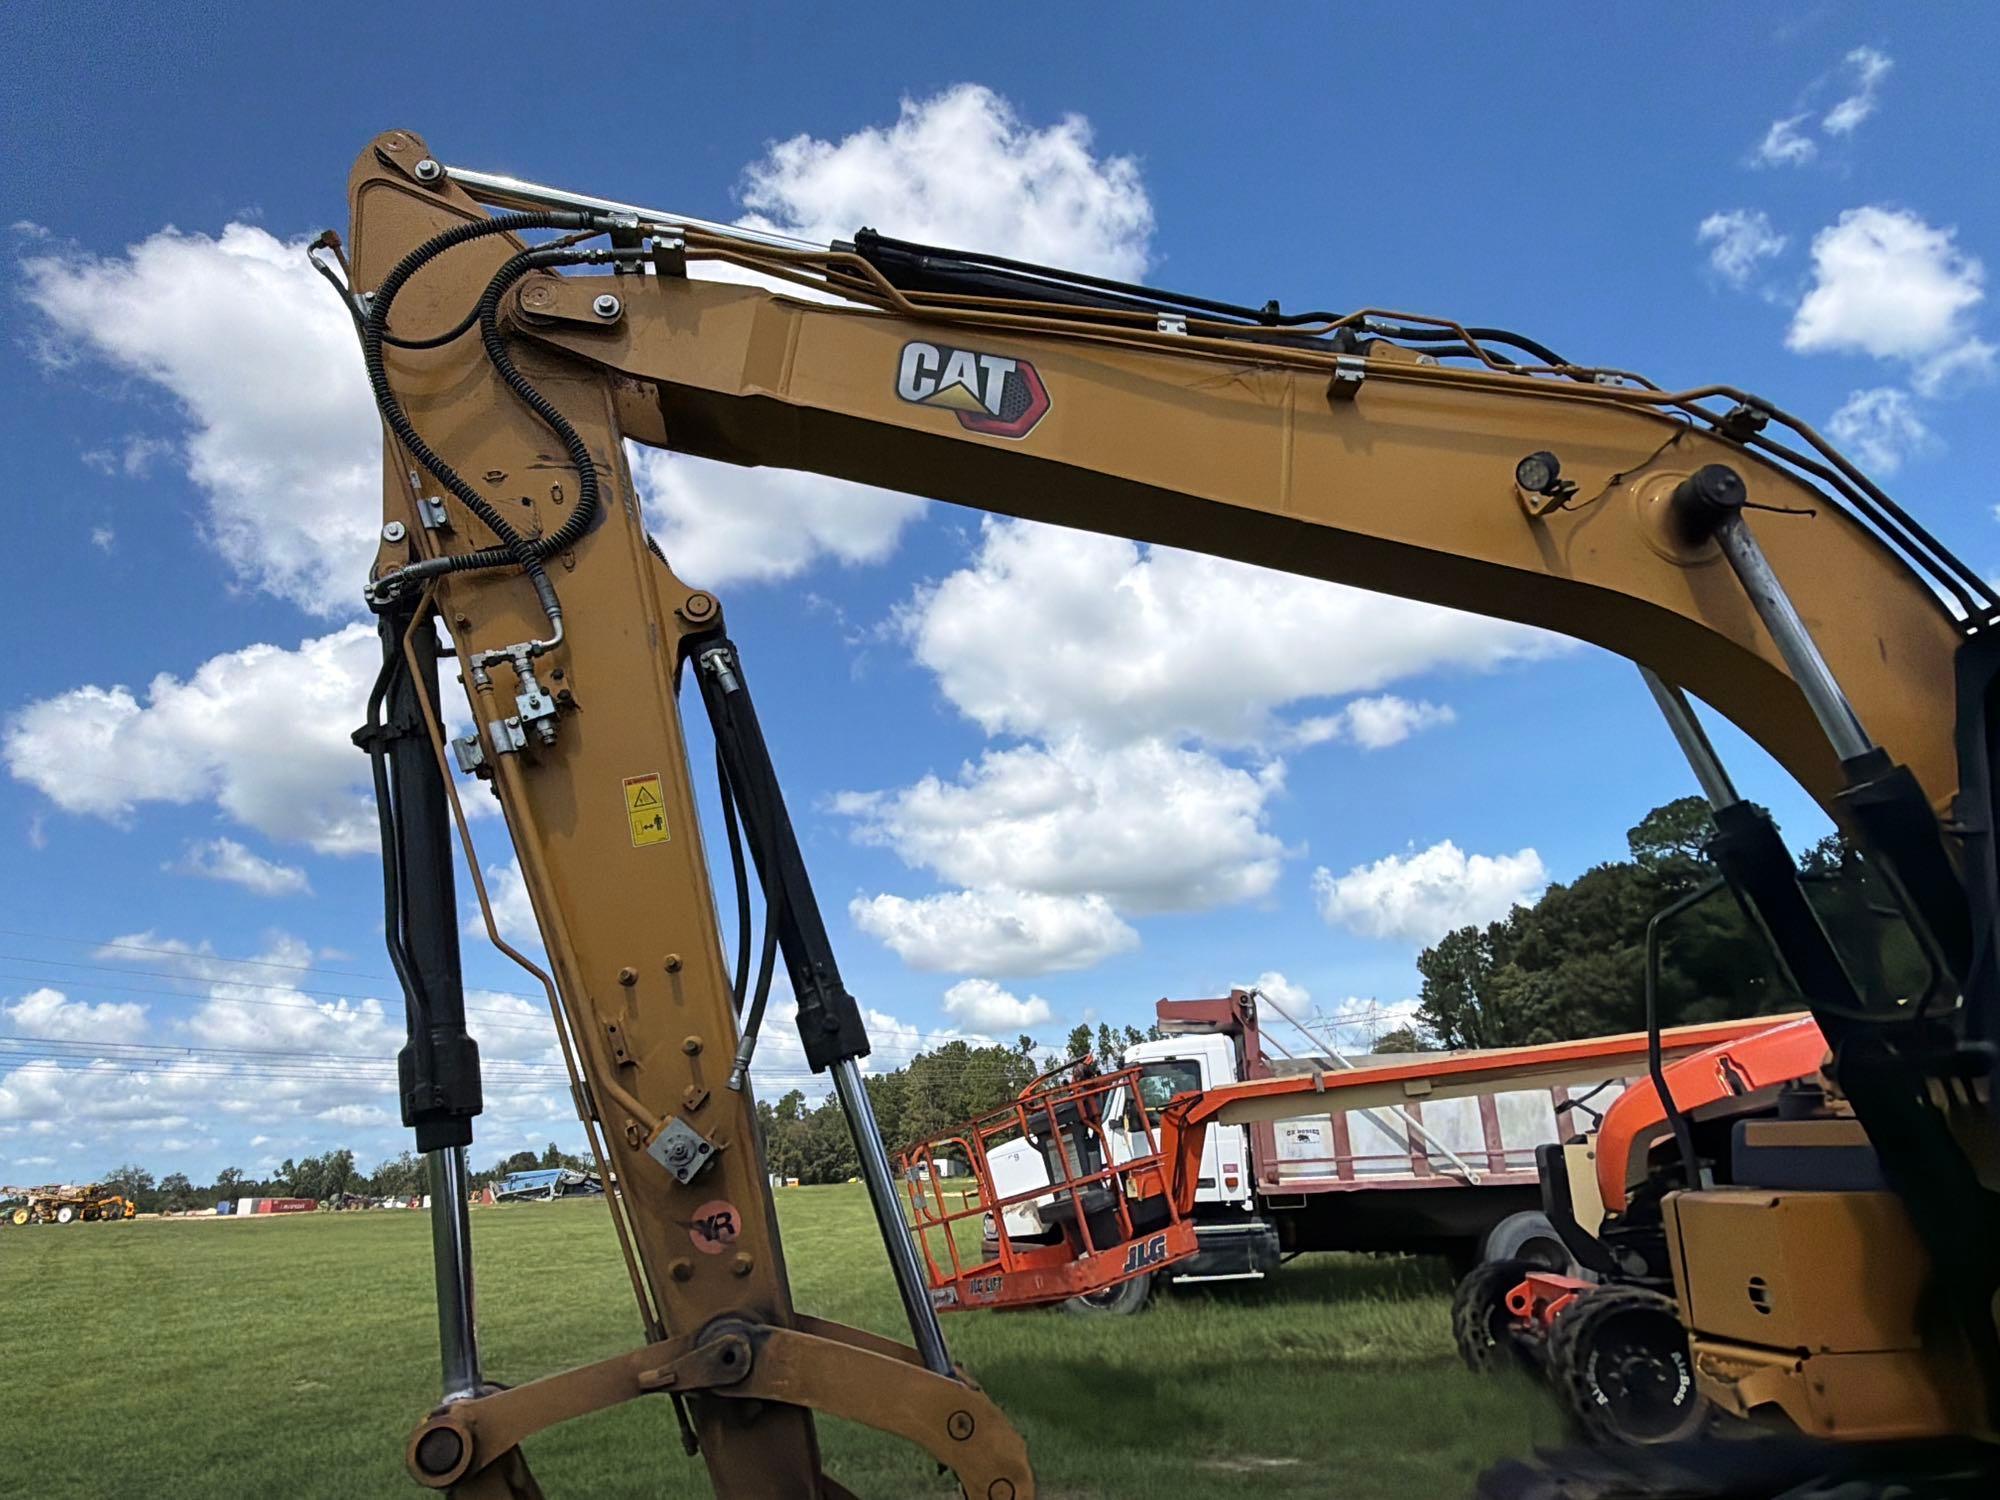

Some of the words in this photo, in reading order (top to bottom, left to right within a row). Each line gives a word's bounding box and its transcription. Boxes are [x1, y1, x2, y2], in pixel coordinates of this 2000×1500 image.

[898, 342, 1016, 416] CAT
[1122, 1233, 1169, 1274] JLG
[1670, 1351, 1691, 1407] AirBoss
